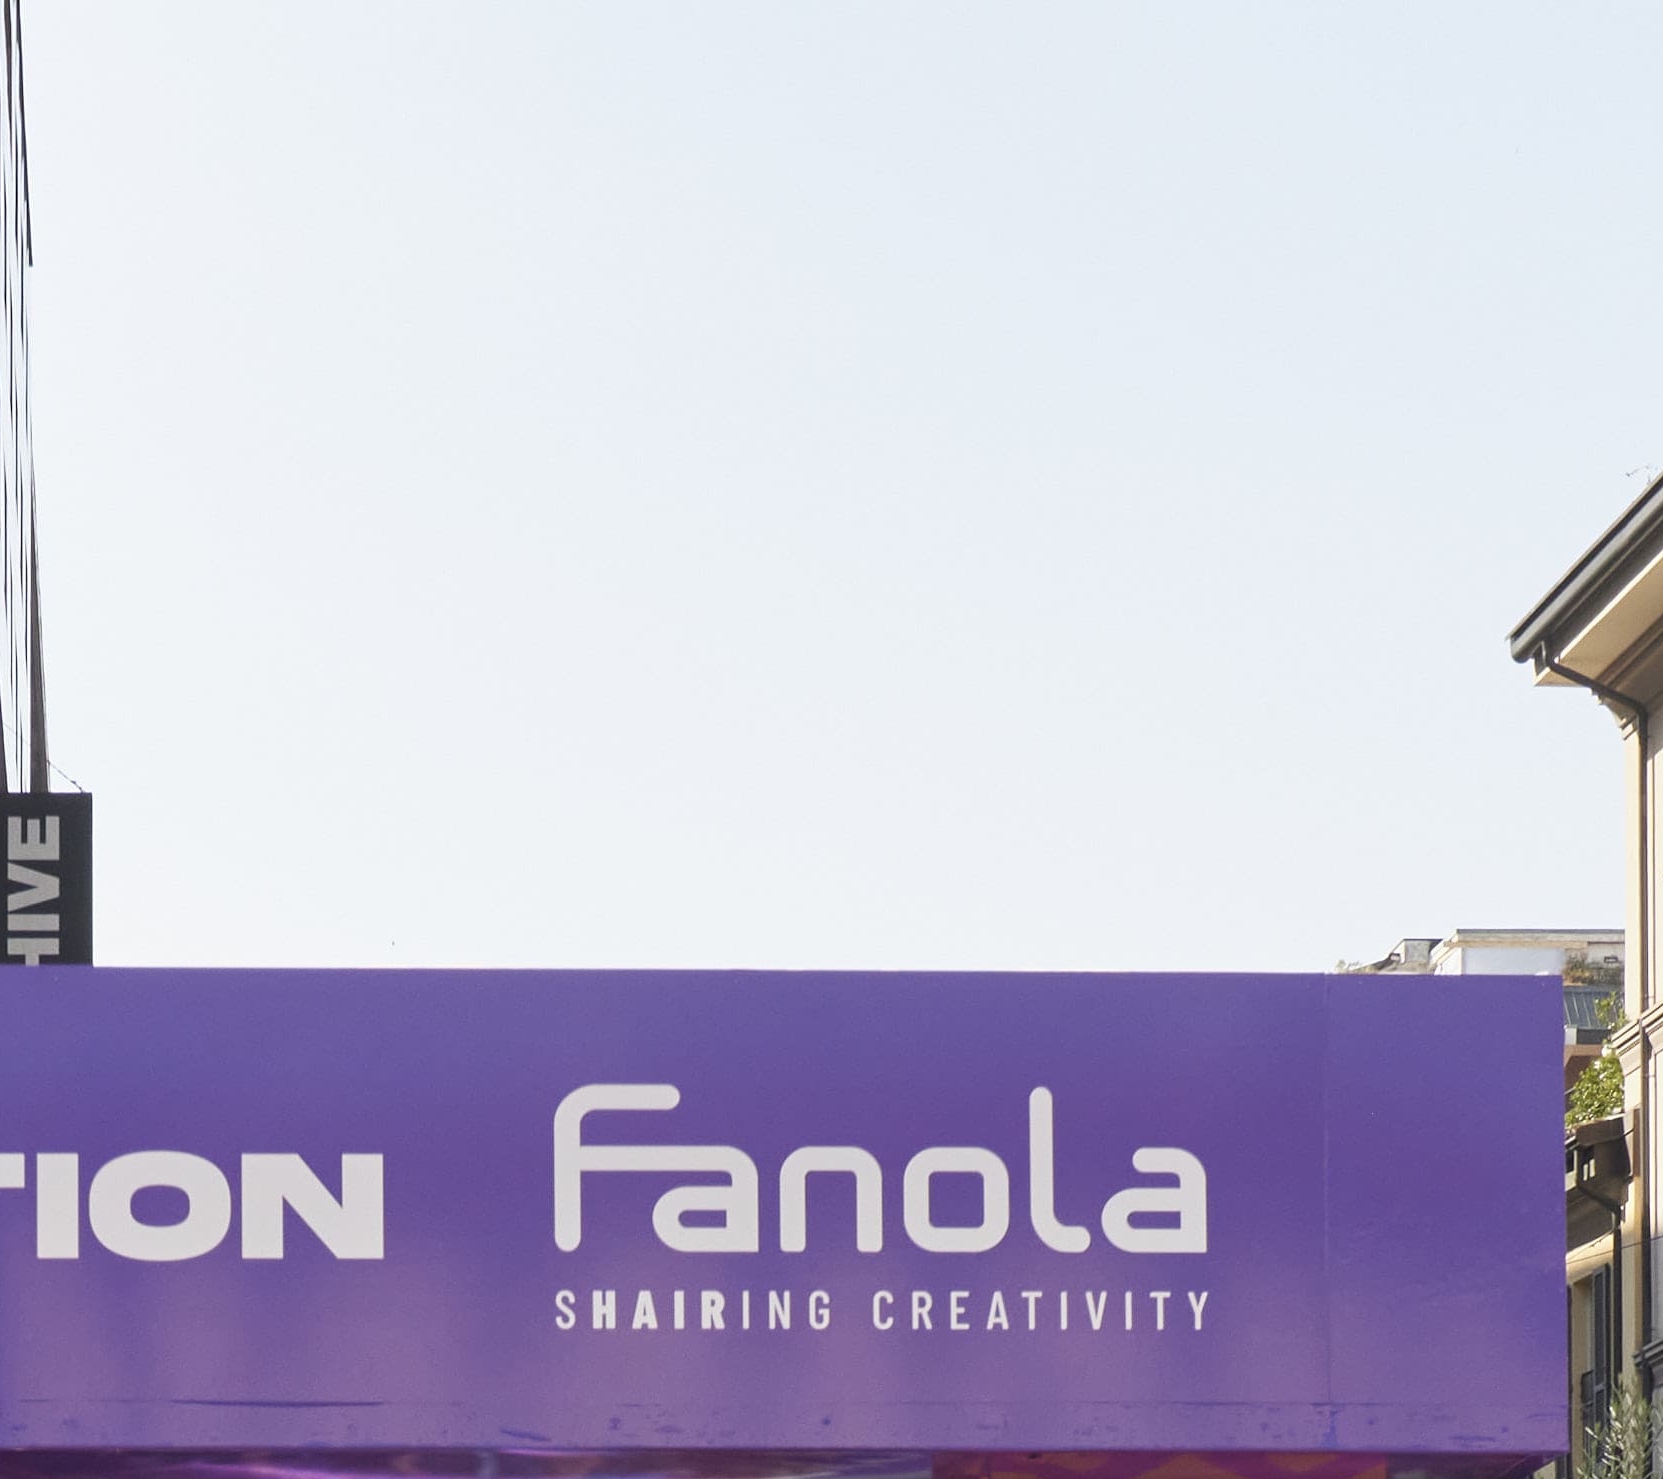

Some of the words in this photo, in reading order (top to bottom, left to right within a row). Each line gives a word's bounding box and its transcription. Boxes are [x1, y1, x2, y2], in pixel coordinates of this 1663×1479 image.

[552, 1082, 1209, 1255] Fanola
[554, 1287, 832, 1332] SHAIRING
[871, 1288, 1210, 1332] CREATIVITY
